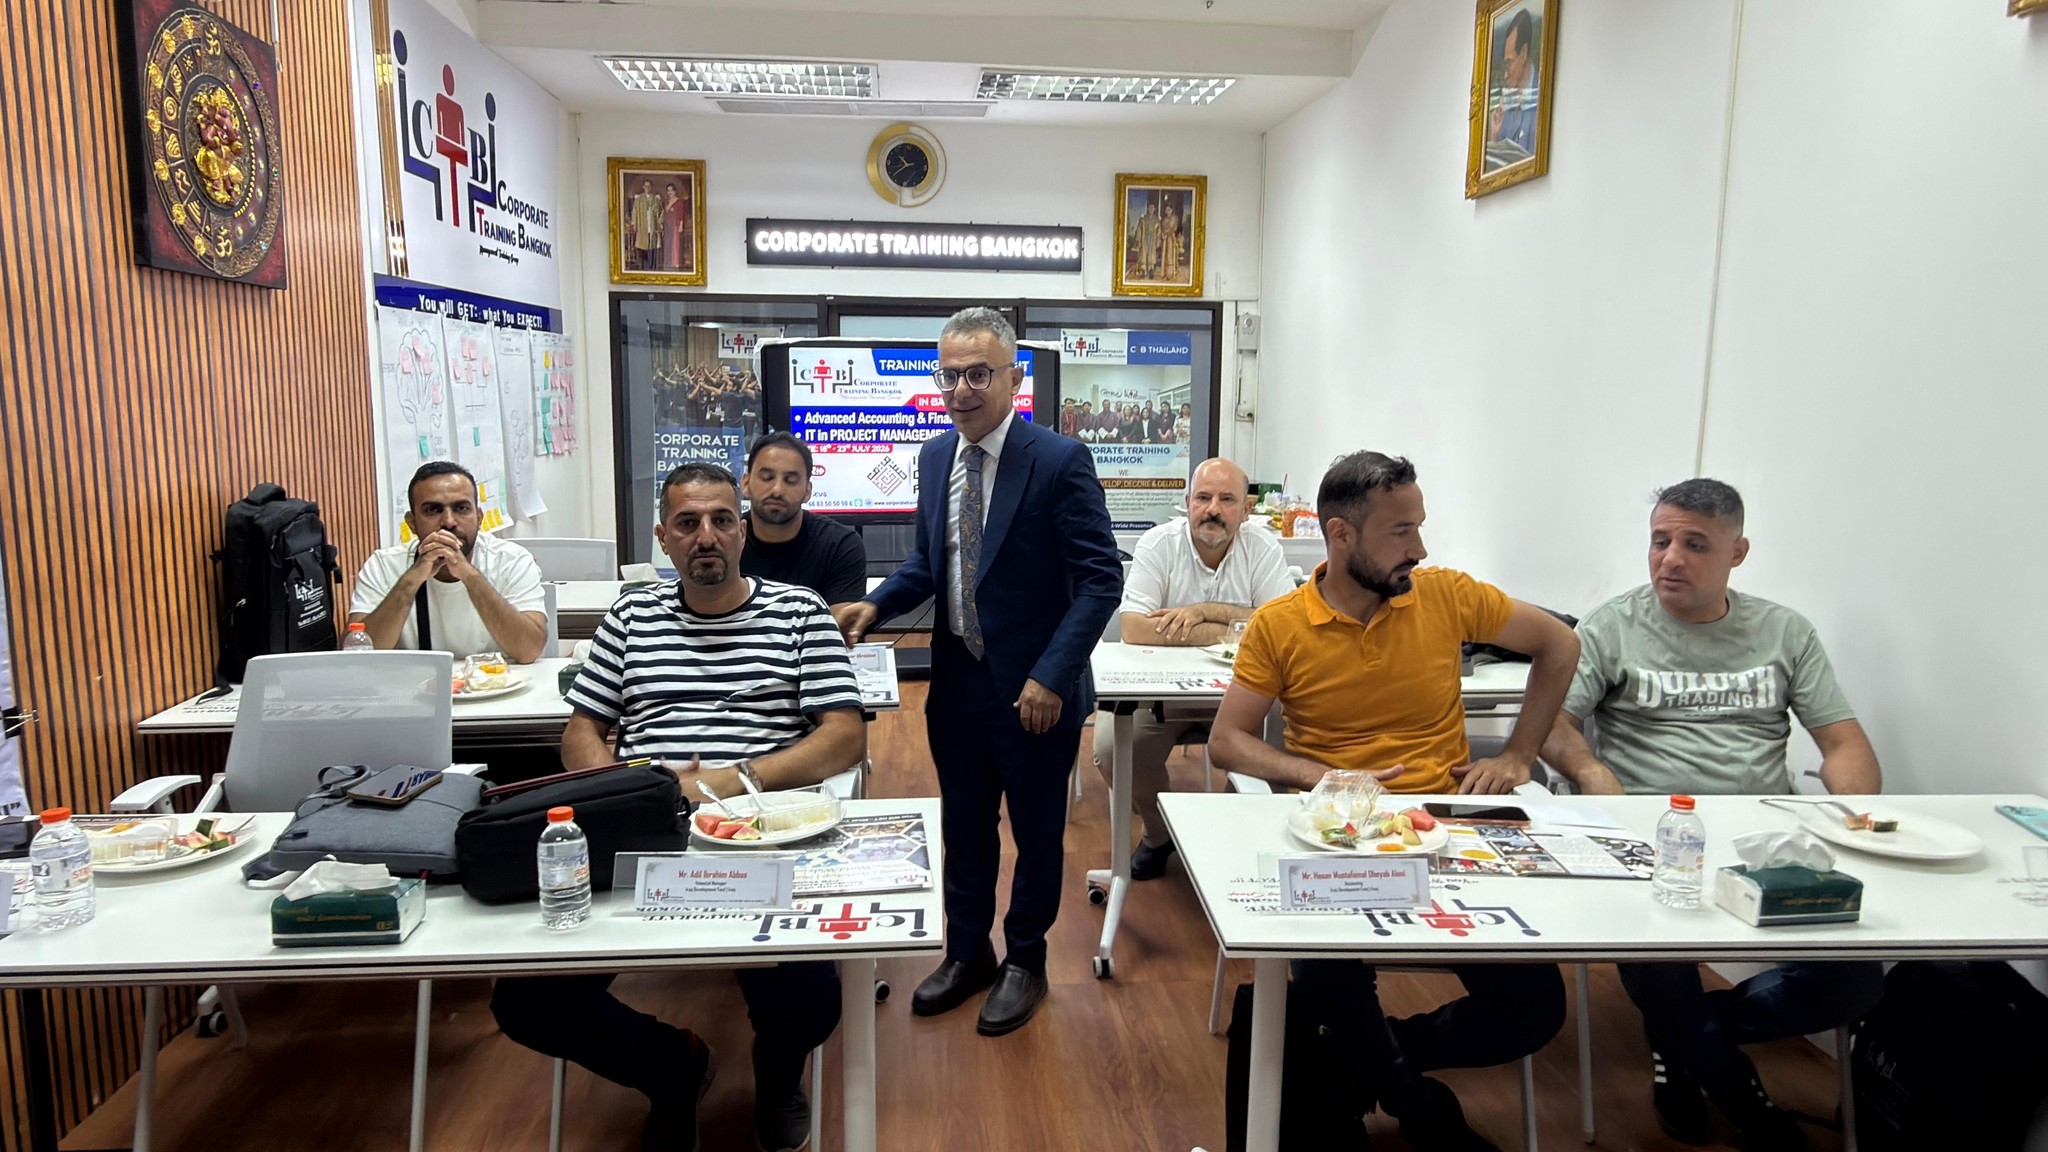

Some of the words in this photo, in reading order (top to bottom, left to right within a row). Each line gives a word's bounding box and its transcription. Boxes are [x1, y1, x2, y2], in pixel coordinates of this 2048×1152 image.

[497, 180, 549, 229] CORPORATE
[476, 206, 516, 246] TRAINING
[518, 222, 552, 259] BANGKOK
[754, 231, 878, 254] CORPORATE
[880, 234, 978, 257] TRAINING
[981, 236, 1079, 259] BANGKOK
[418, 294, 437, 312] You
[439, 298, 454, 314] will
[457, 303, 478, 318] GET:
[482, 307, 500, 323] what
[502, 309, 515, 324] You
[516, 312, 543, 329] EXPECT!
[1148, 346, 1189, 354] THAILAND
[804, 411, 856, 425] Advanced
[858, 412, 915, 427] Accounting
[917, 413, 926, 424] &
[805, 429, 816, 441] IT
[818, 429, 828, 441] in
[830, 429, 878, 441] PROJECT
[662, 447, 728, 460] TRAINING
[1127, 446, 1170, 455] TRAINING
[1096, 456, 1143, 464] BANGKOK
[1636, 664, 1777, 709] DULUTH
[1665, 692, 1754, 708] TRADING
